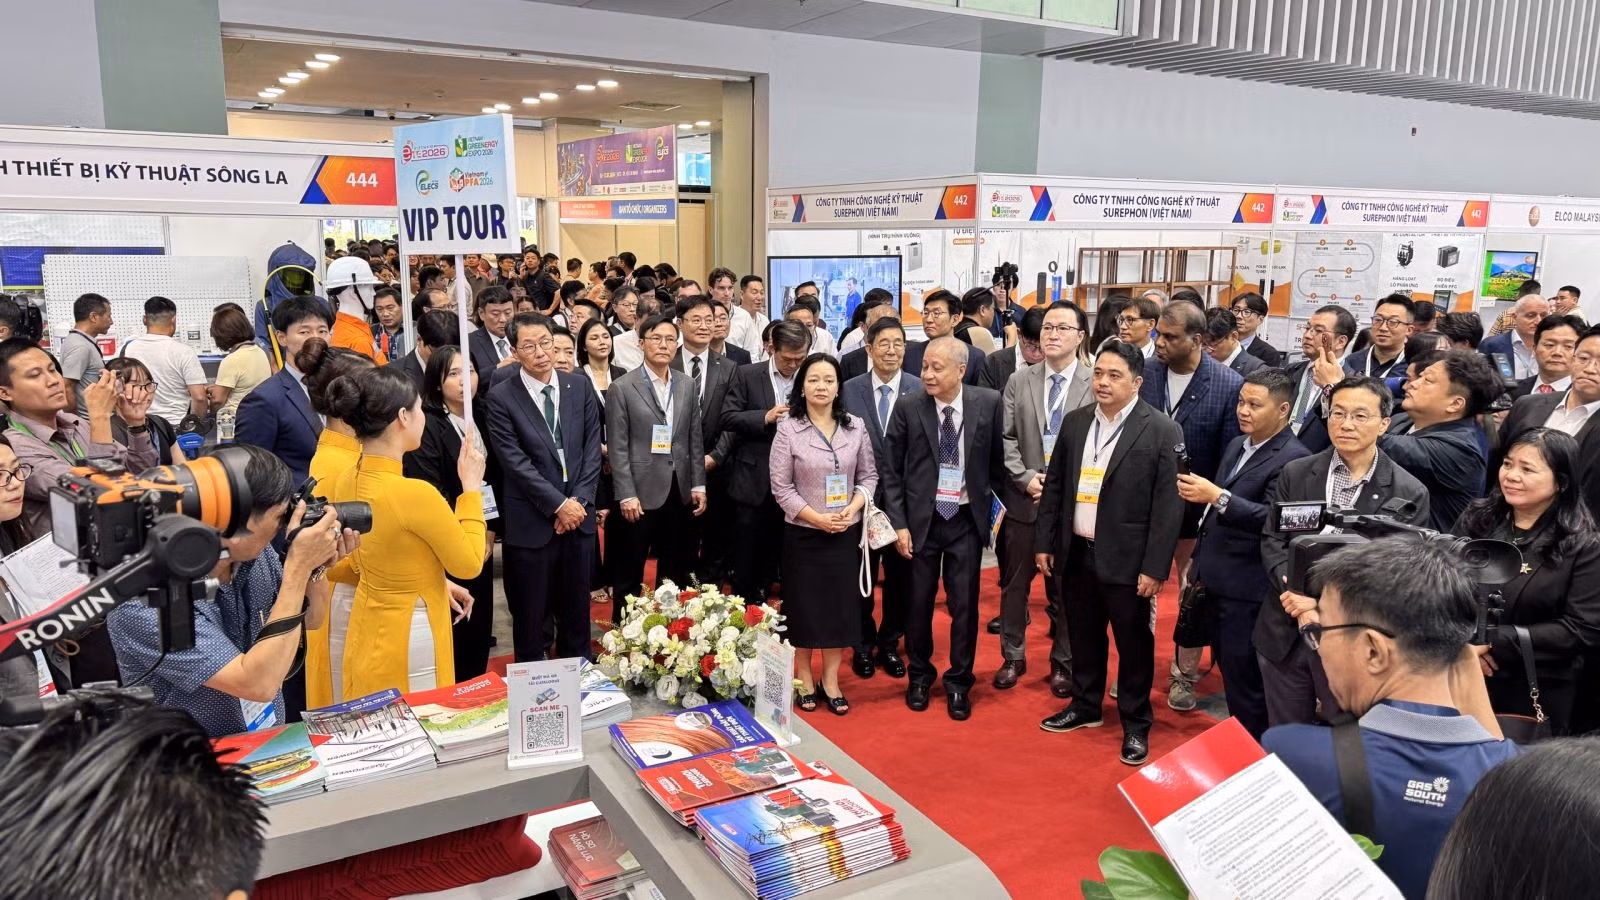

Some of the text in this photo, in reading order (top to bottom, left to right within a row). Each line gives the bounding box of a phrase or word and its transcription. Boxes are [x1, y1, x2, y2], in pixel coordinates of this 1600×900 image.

[468, 140, 498, 149] GREENERGY
[12, 157, 74, 177] THIẾT
[80, 163, 100, 183] BỊ
[105, 160, 131, 180] KỸ
[138, 164, 200, 186] THUẬT
[206, 165, 260, 185] SÔNG
[265, 170, 288, 185] LA
[346, 172, 378, 188] 444
[420, 182, 439, 190] ELECS
[464, 177, 493, 187] PFA 2026
[815, 192, 923, 207] CÔNG TY TNHH CÔNG NGHỆ KỸ THUẬT
[953, 194, 968, 206] 442
[1073, 193, 1220, 208] CÔNG TY TNHH CÔNG NGHỆ KỸ THUẬT
[834, 205, 899, 219] SUREPHON (VIỆT NAM)
[1103, 207, 1192, 221] SUREPHON (VIỆT NAM)
[1252, 203, 1265, 213] 442
[1341, 201, 1449, 215] CÔNG TY TNHH CÔNG NGHỆ KỸ THUẬT
[1471, 210, 1482, 218] 442
[403, 204, 507, 241] VIP TOUR
[1363, 213, 1427, 224] SUREPHON (VIỆT NAM)
[1555, 211, 1572, 222] ELCO
[15, 587, 115, 650] RONIN
[530, 705, 548, 713] SCAN
[1407, 780, 1433, 791] GAS
[1405, 789, 1446, 802] SOUTH
